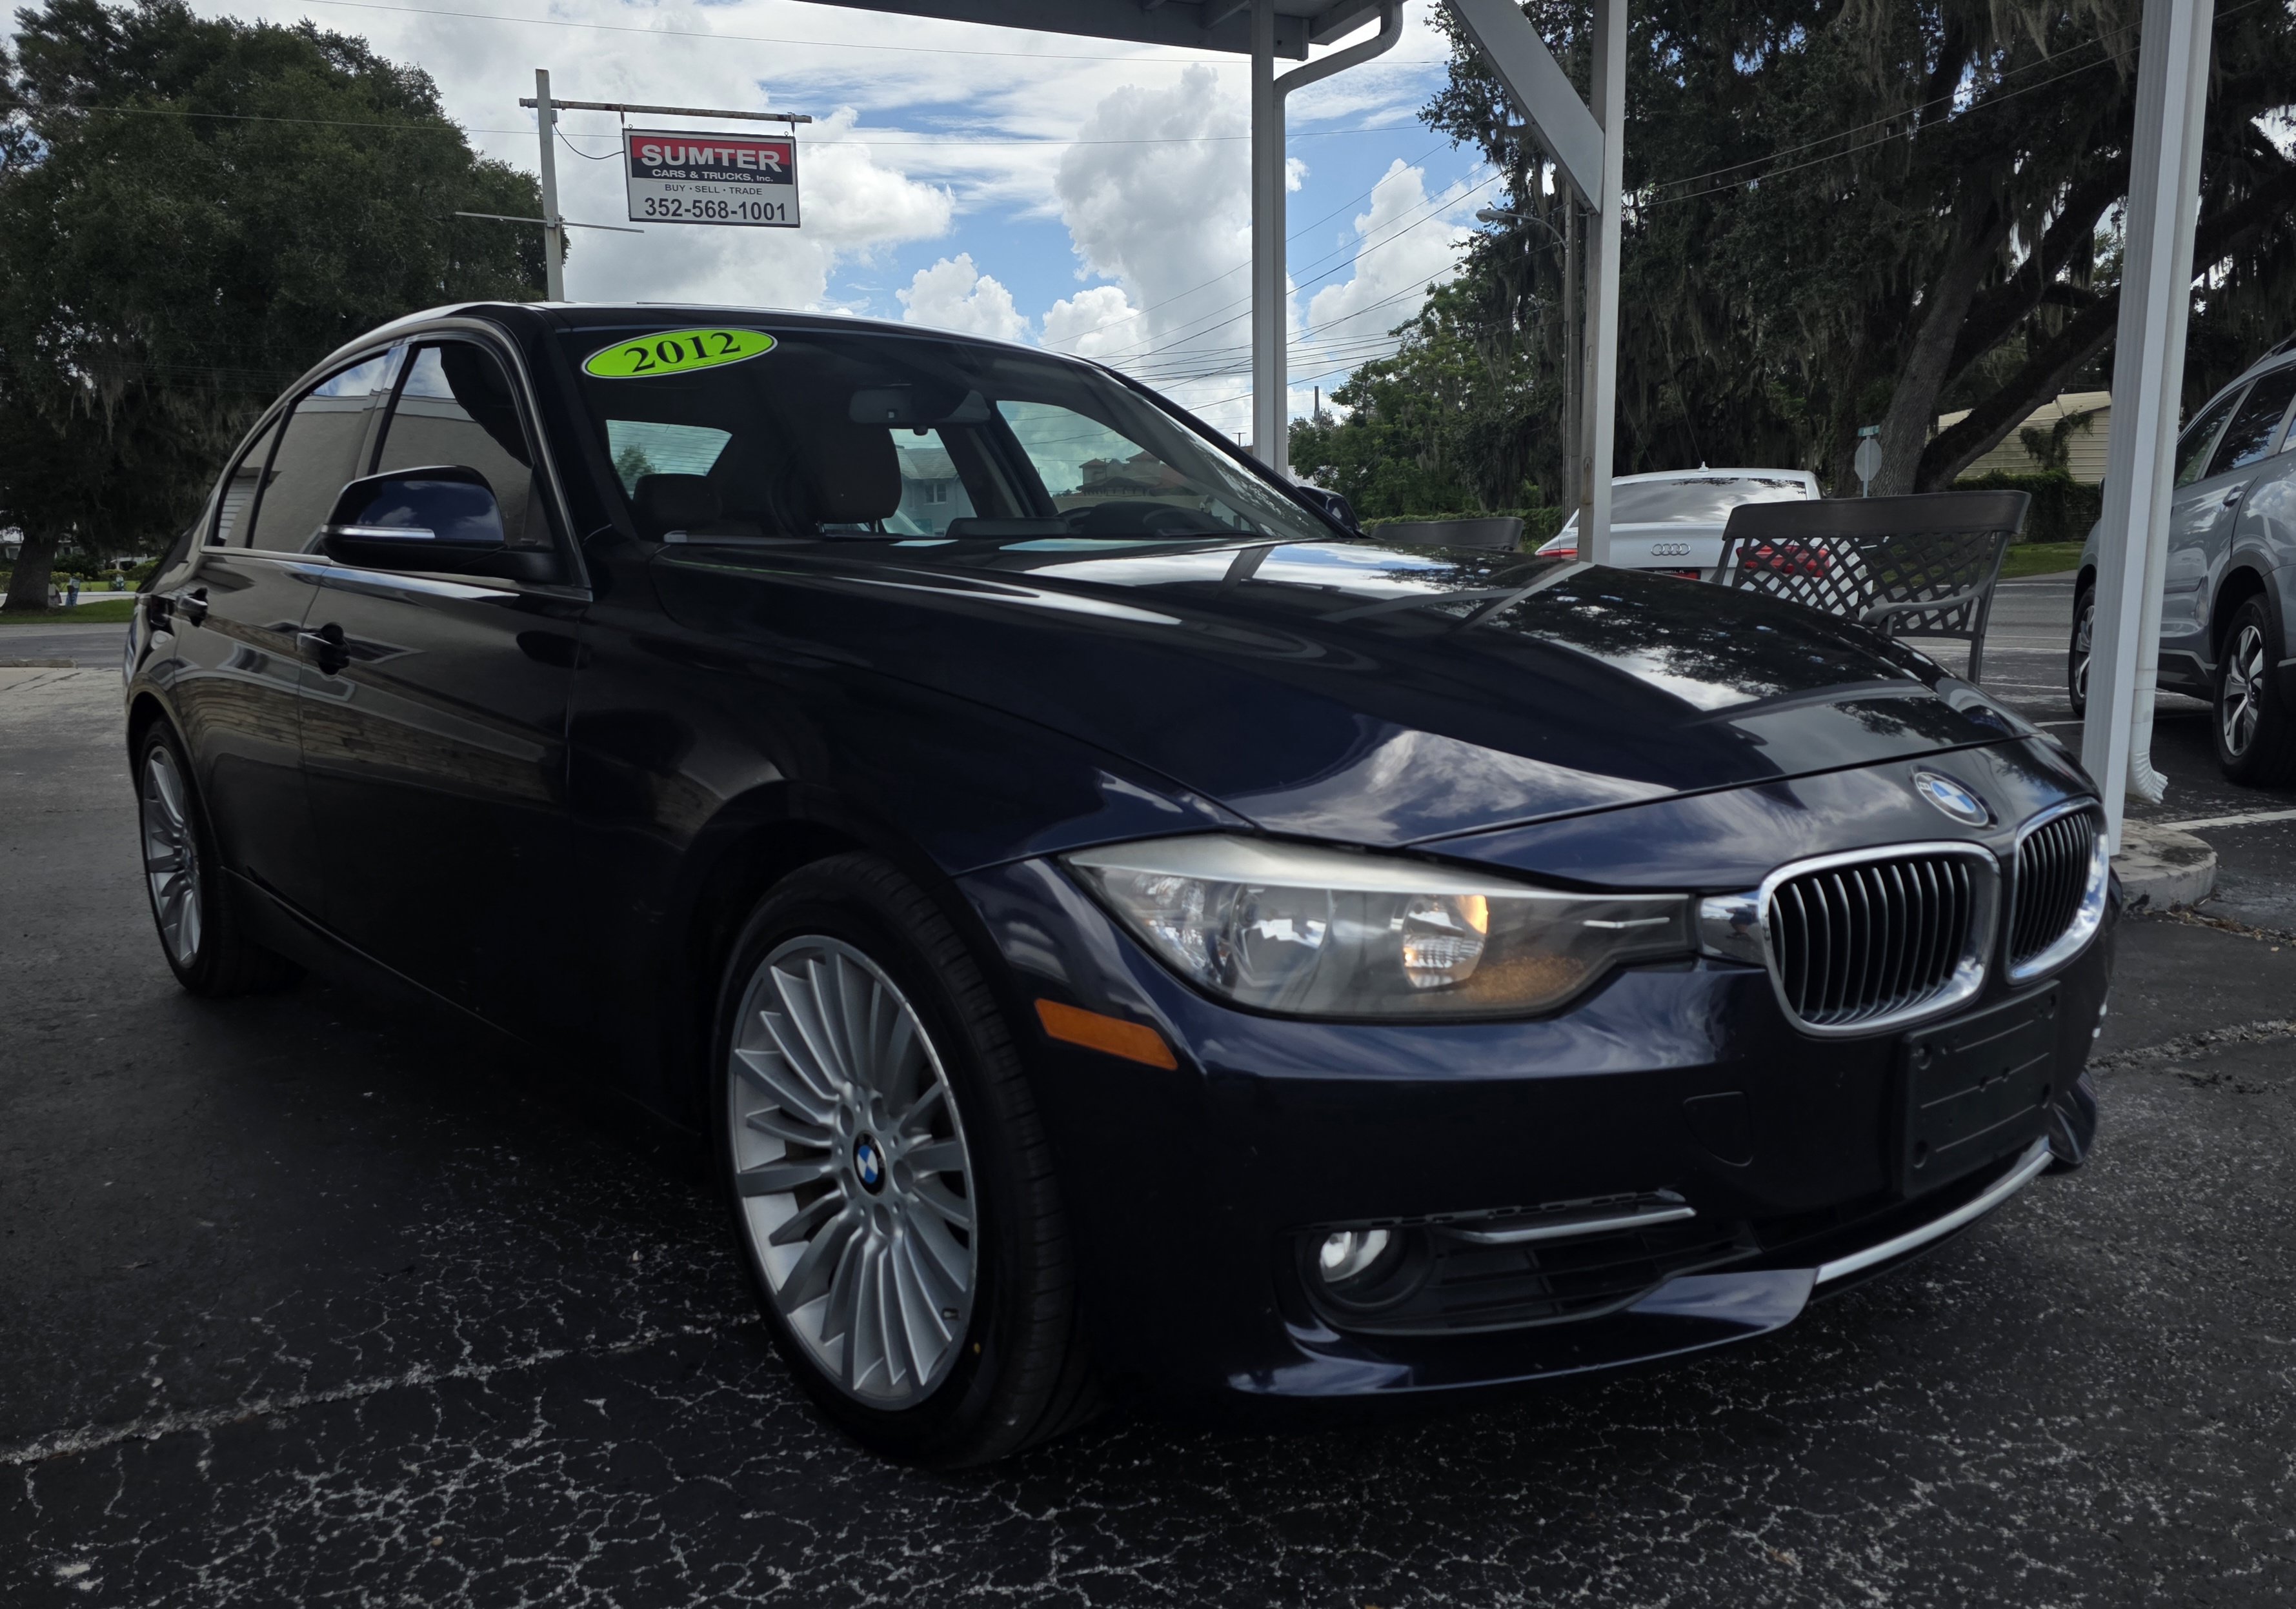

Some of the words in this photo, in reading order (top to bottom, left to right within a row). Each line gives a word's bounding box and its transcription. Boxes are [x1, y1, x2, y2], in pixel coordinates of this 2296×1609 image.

[641, 145, 782, 172] SUMTER
[652, 169, 686, 178] CARS
[702, 171, 754, 182] TRUCKS,
[695, 185, 720, 194] SELL
[645, 197, 785, 221] 352-568-1001
[624, 332, 741, 373] 2012
